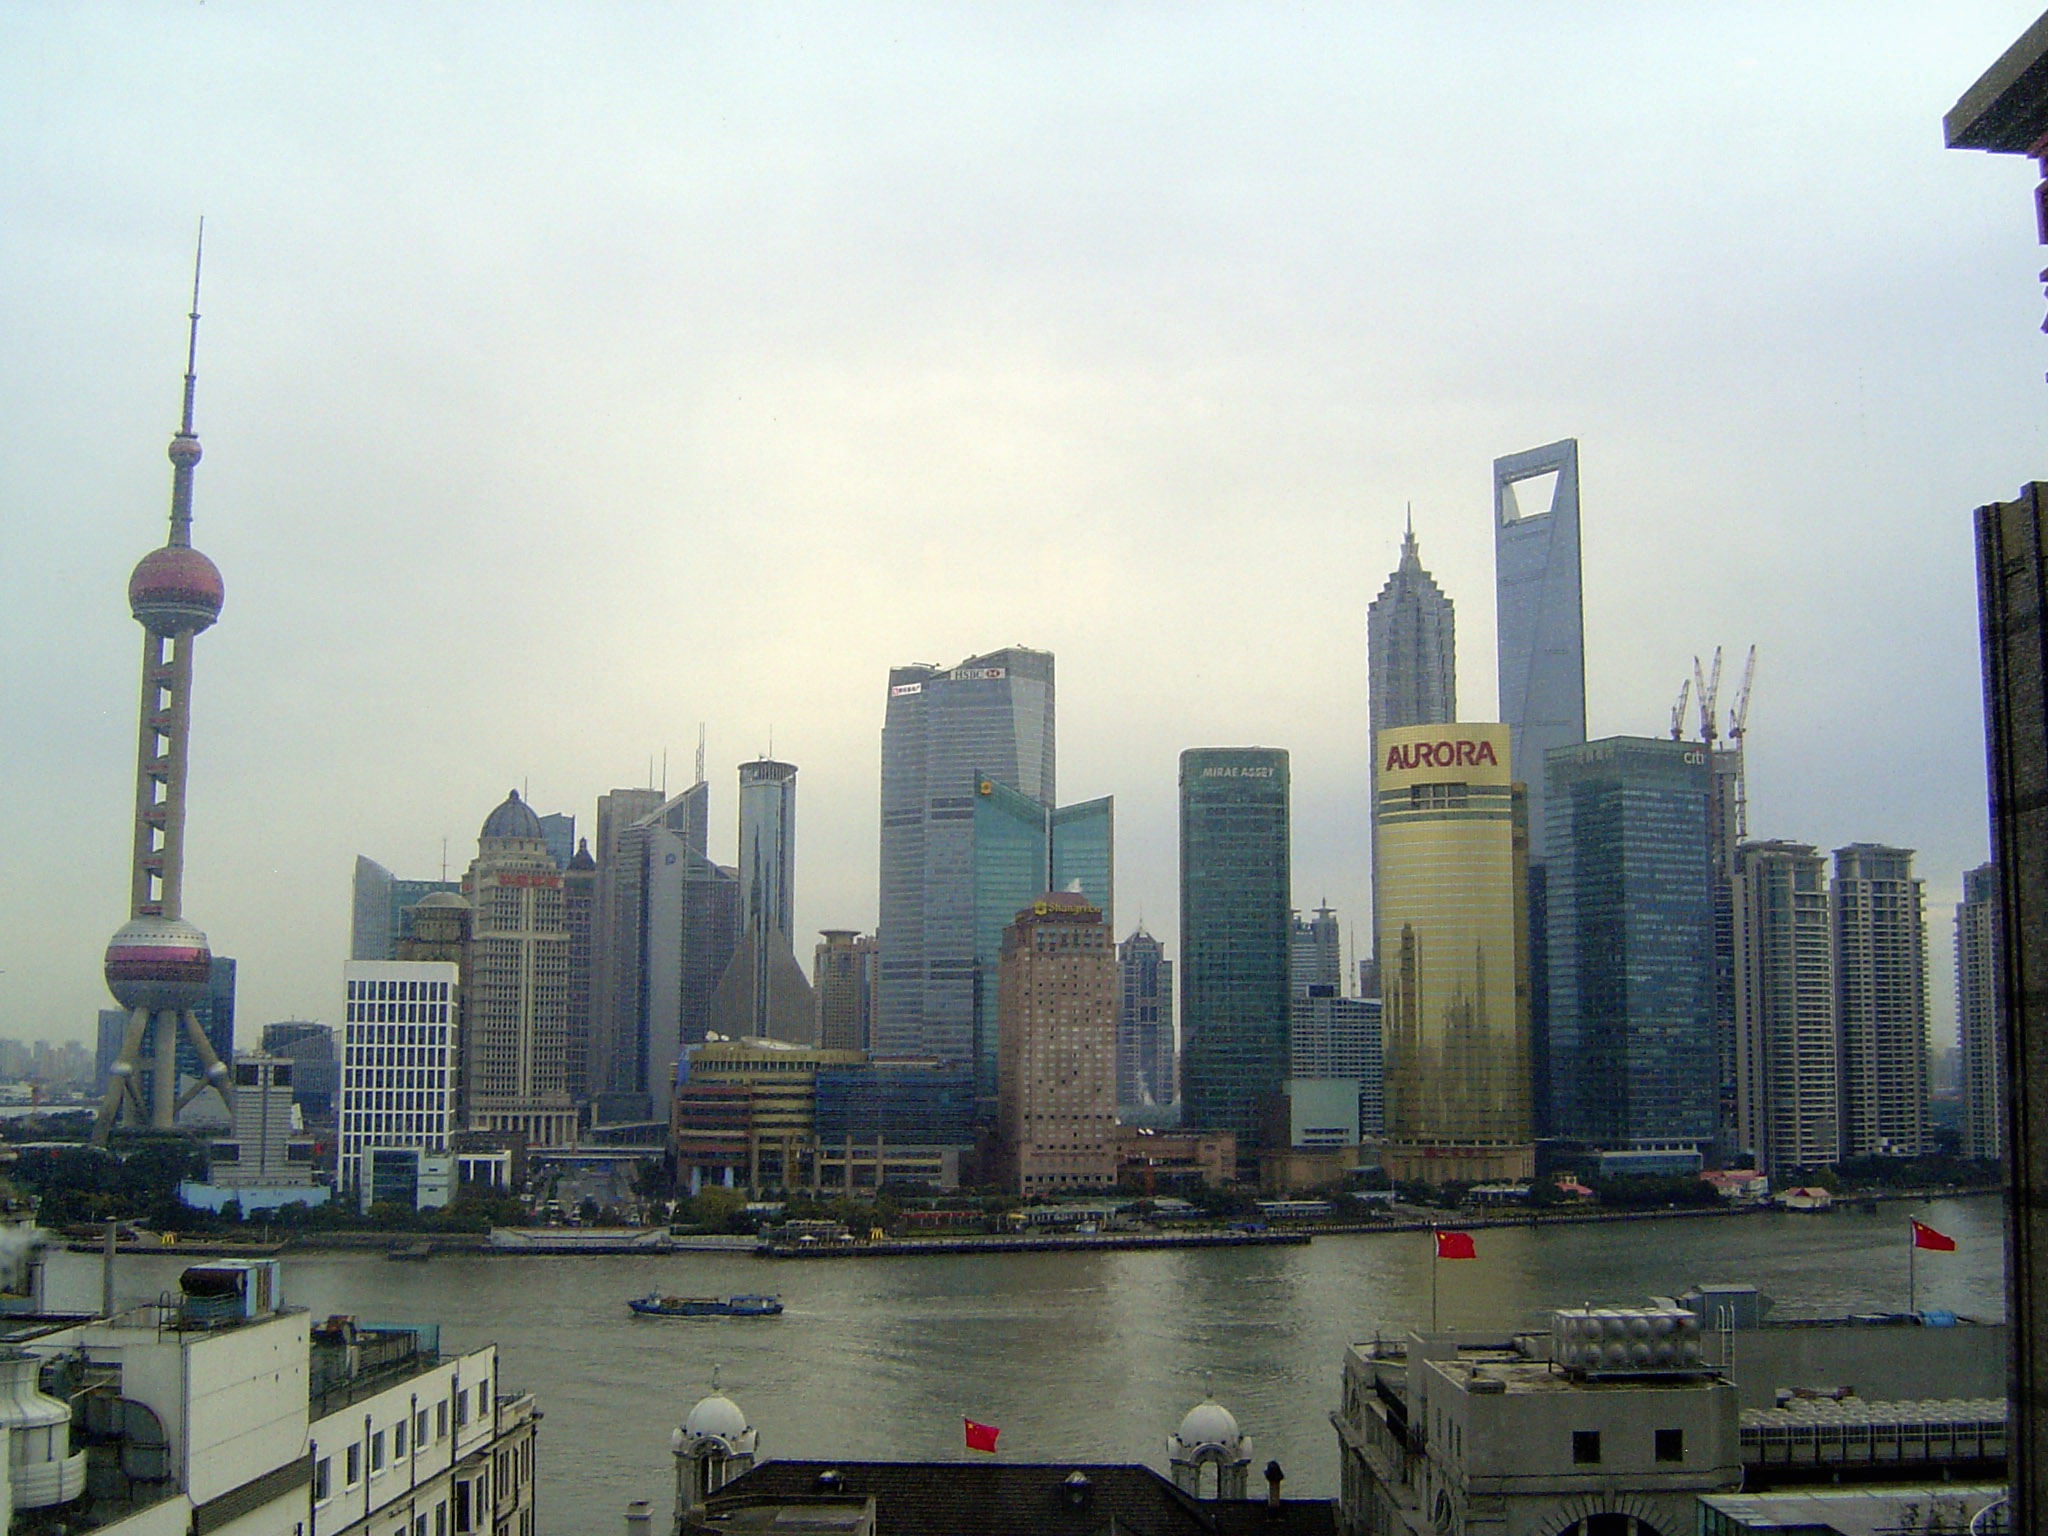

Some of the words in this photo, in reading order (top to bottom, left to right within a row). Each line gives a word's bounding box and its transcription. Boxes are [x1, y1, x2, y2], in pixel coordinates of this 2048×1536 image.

[955, 670, 984, 680] HSBC
[1386, 740, 1498, 771] AURORA
[1684, 750, 1704, 764] citi
[1203, 767, 1238, 777] MIRAE
[1241, 767, 1274, 777] ASSET
